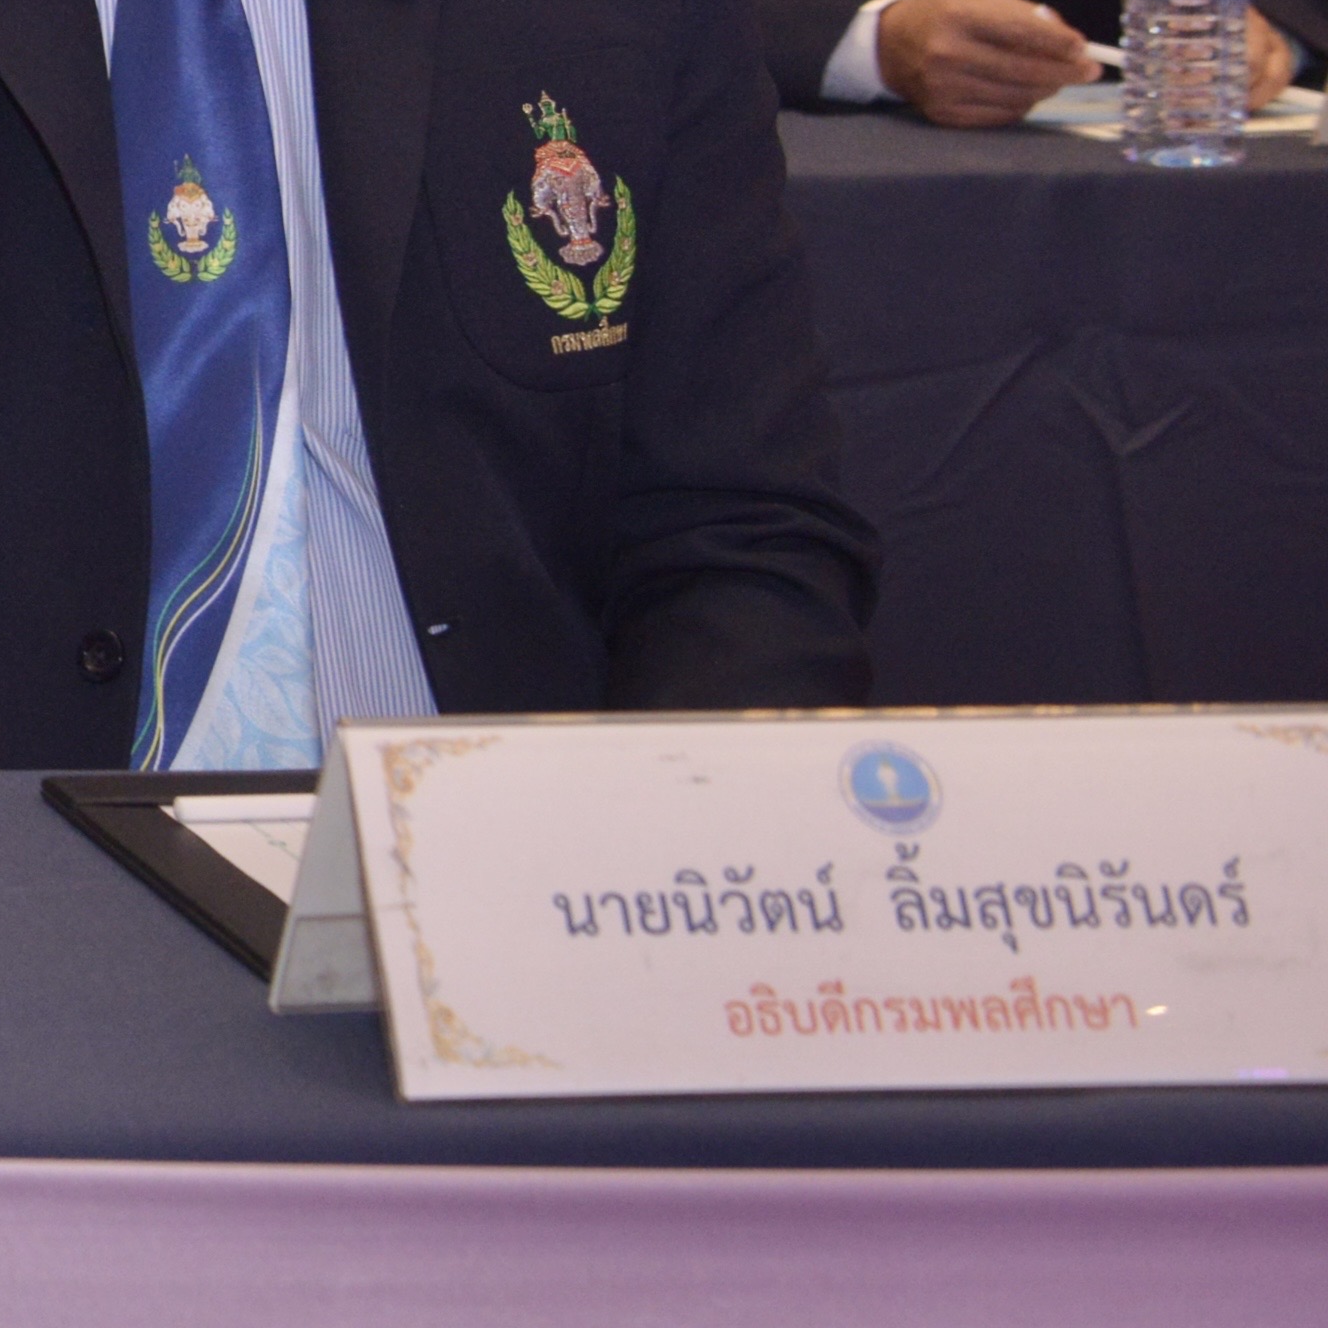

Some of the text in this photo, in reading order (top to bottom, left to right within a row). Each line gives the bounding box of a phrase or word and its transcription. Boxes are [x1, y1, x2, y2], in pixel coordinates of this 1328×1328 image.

[551, 843, 1253, 953] นายนิวัตน์ ลิ้มสุขนิรันดร์
[724, 974, 1139, 1037] อธิบดีกรมพลศึกษา
